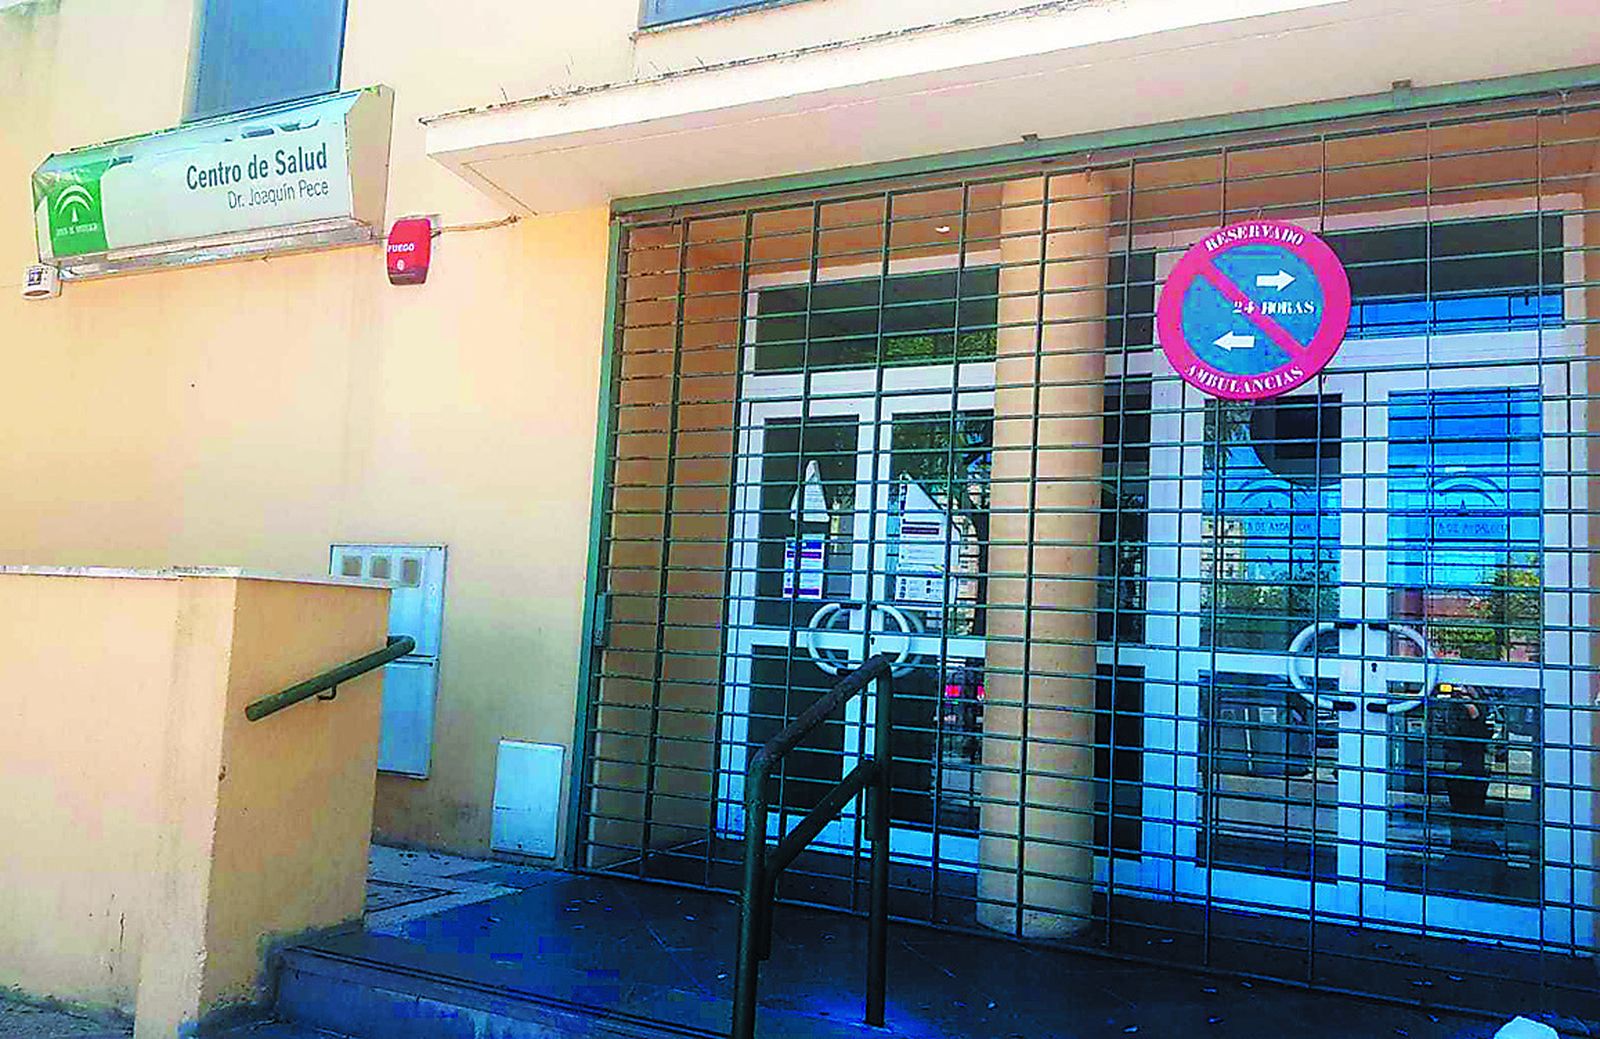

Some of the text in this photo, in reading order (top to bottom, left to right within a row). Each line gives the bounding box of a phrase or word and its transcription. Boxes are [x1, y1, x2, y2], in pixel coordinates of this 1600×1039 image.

[186, 142, 328, 190] Centro de Salud
[227, 179, 329, 209] Dr. Joaquín Pece
[1204, 224, 1305, 252] RESERVADO
[1231, 300, 1315, 315] 24 HORAS
[1184, 365, 1305, 394] AMBULANCIAS
